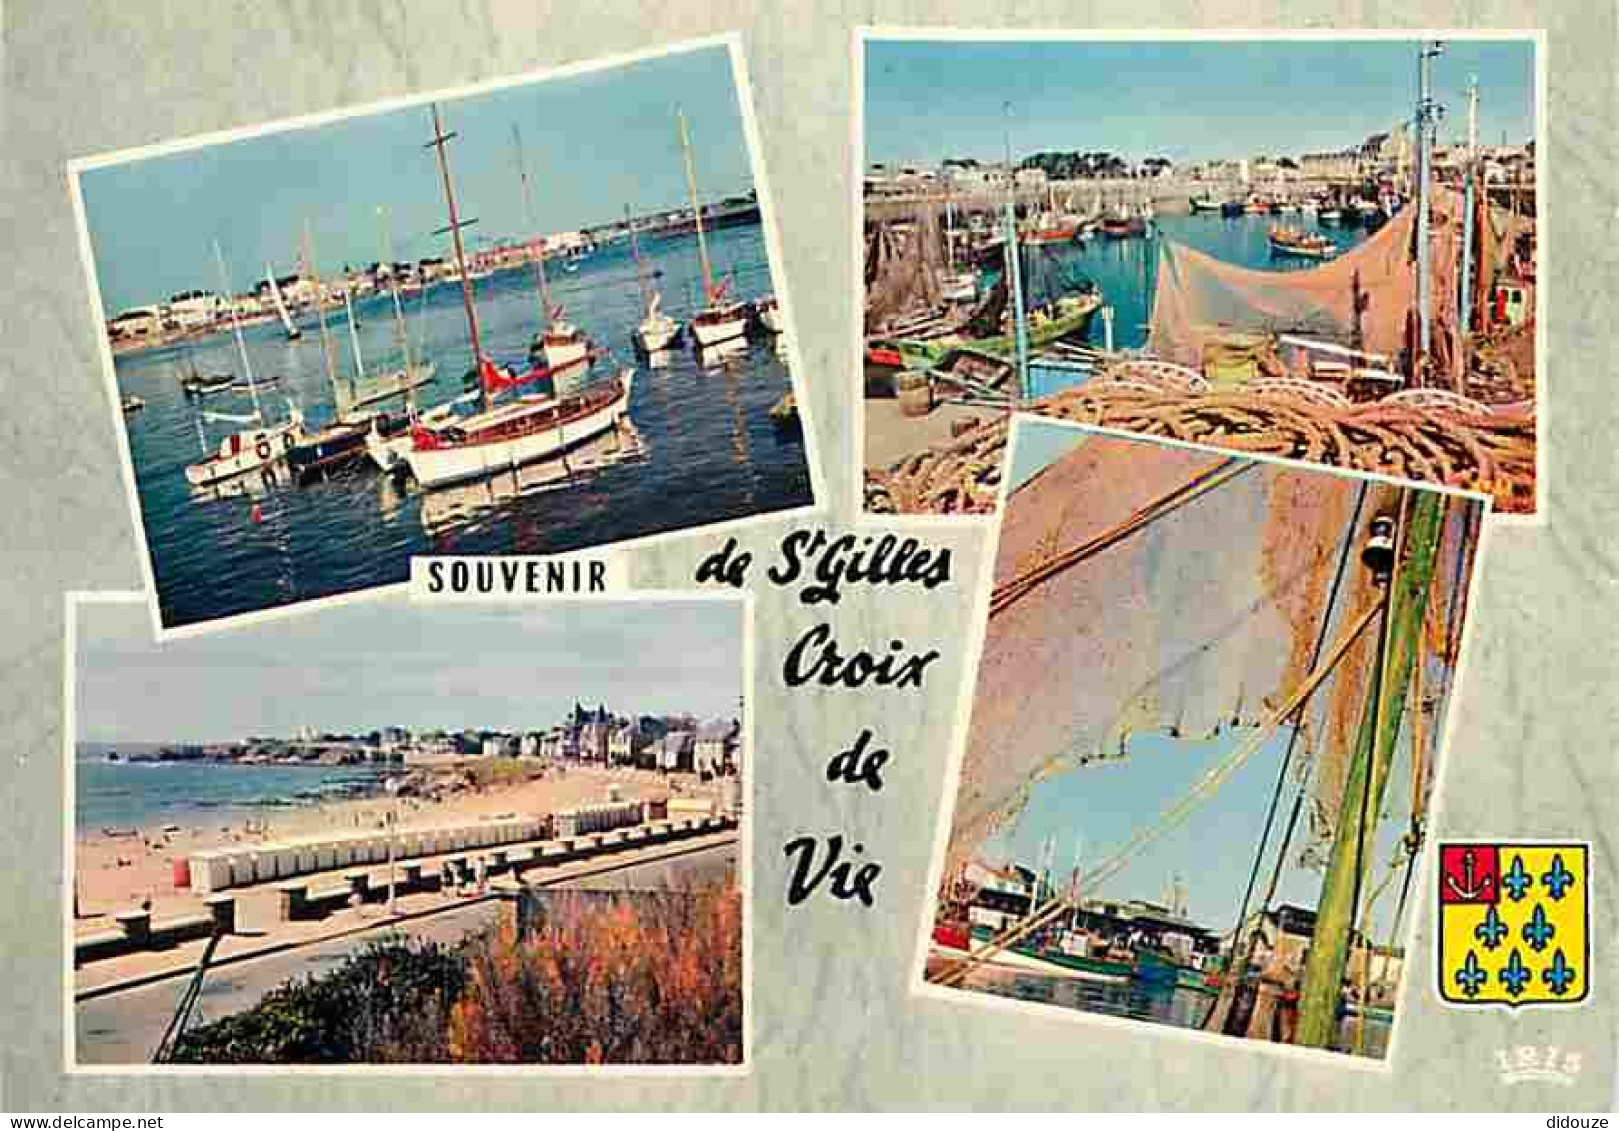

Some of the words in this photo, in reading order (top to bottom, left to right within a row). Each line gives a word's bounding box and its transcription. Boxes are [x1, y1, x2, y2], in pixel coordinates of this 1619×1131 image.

[429, 561, 605, 593] SOUVENIR
[695, 537, 752, 588] de
[783, 623, 940, 688] Croix
[826, 729, 889, 791] de
[783, 835, 882, 907] Vie
